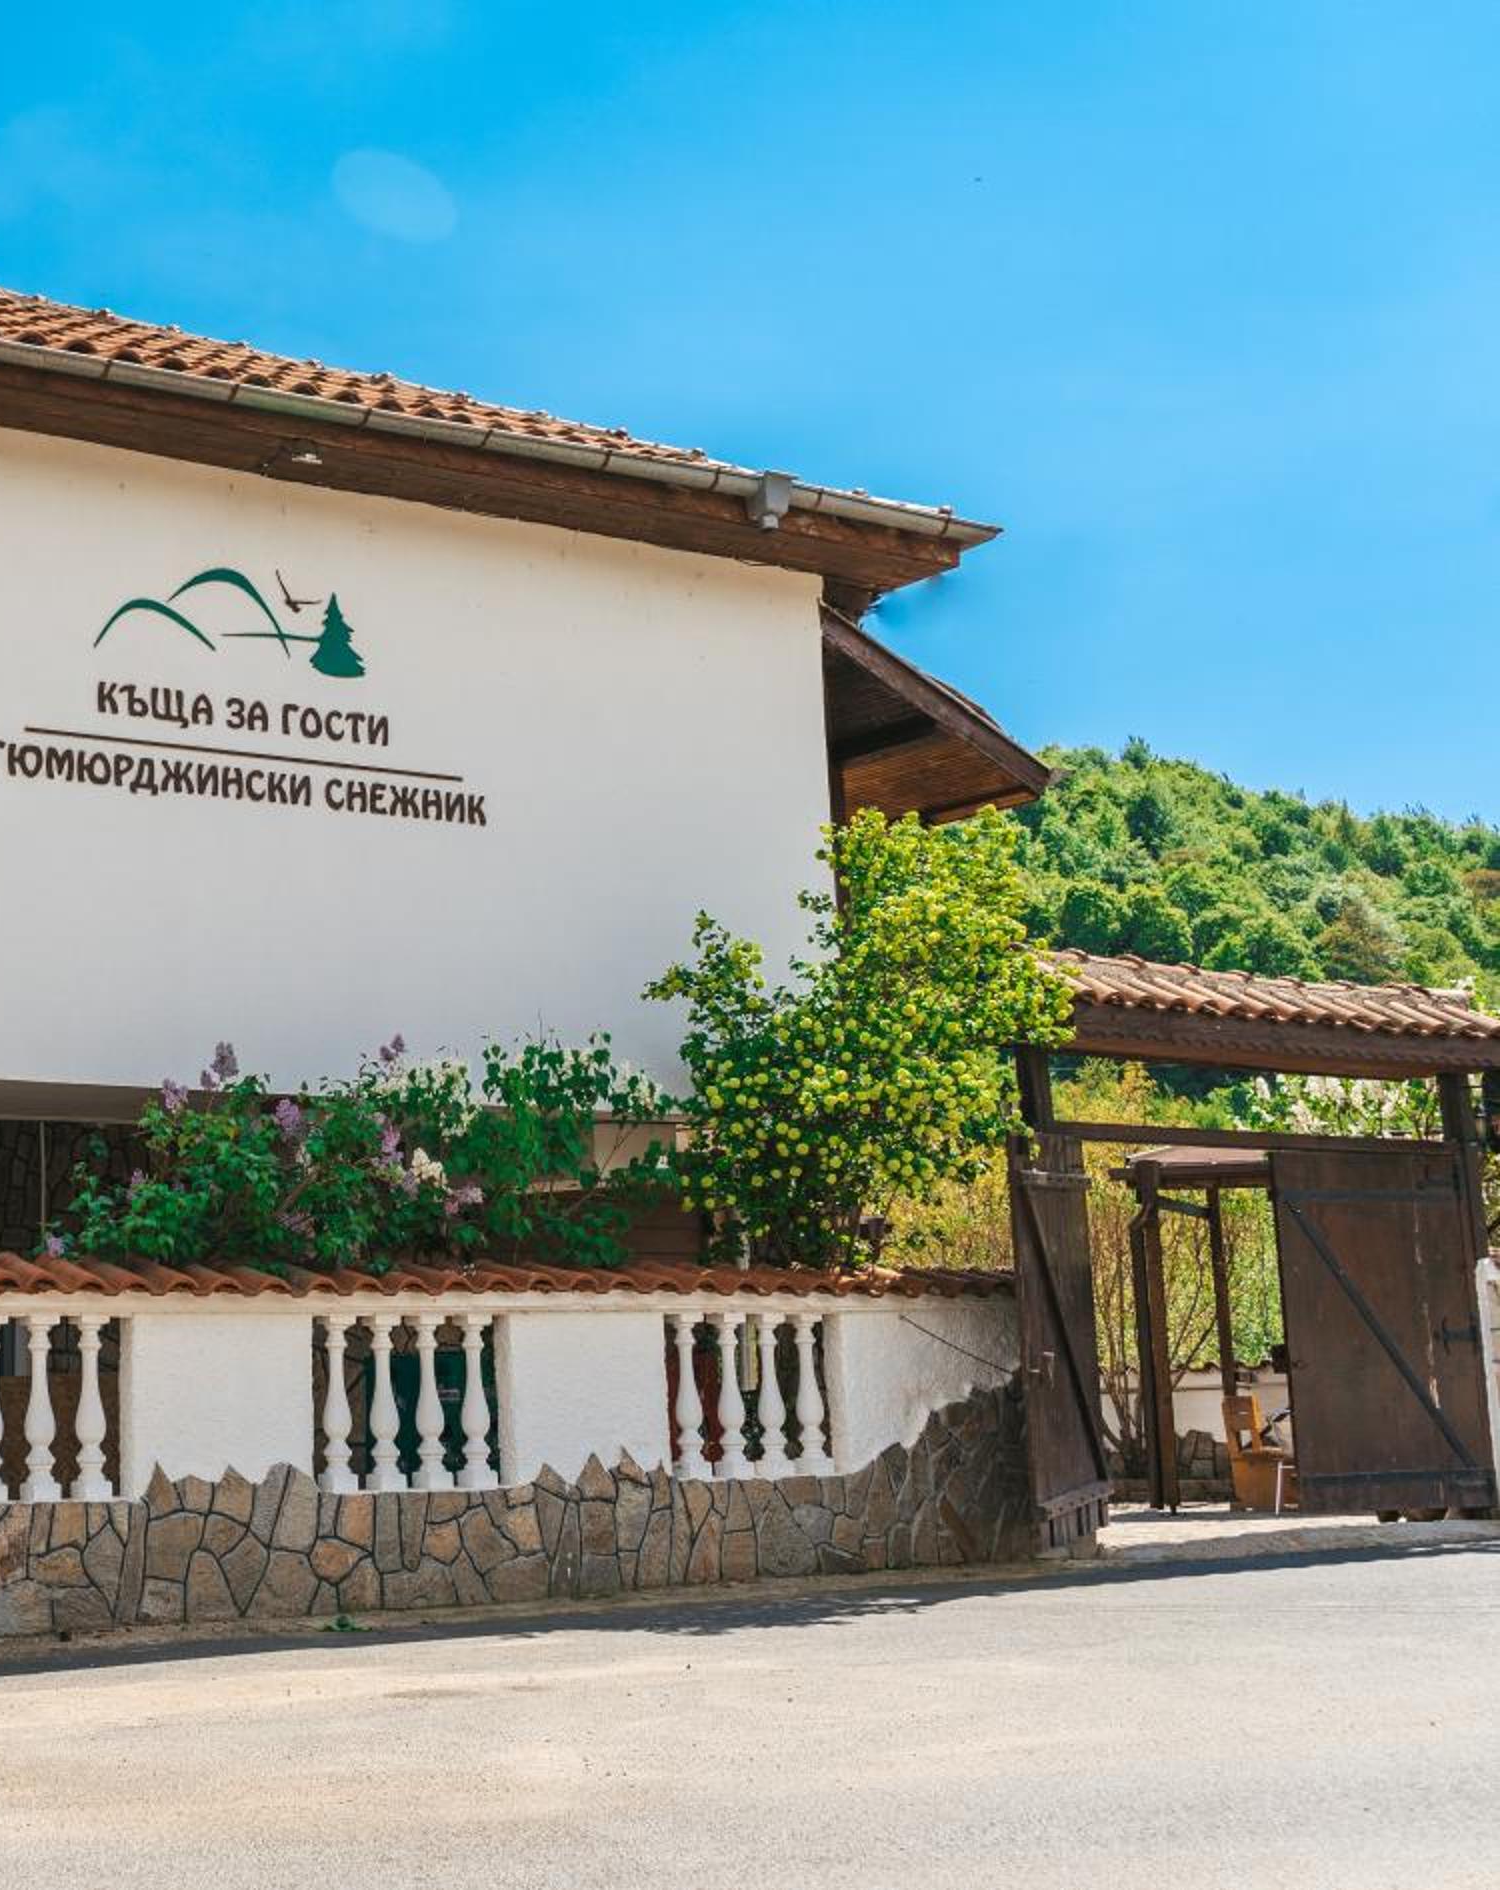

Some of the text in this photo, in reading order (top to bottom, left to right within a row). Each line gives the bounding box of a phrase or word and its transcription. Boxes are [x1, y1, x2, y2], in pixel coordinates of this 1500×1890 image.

[97, 681, 390, 747] КЪЩА ЗА ГОСТИ
[324, 778, 487, 827] СНЕЖНИК
